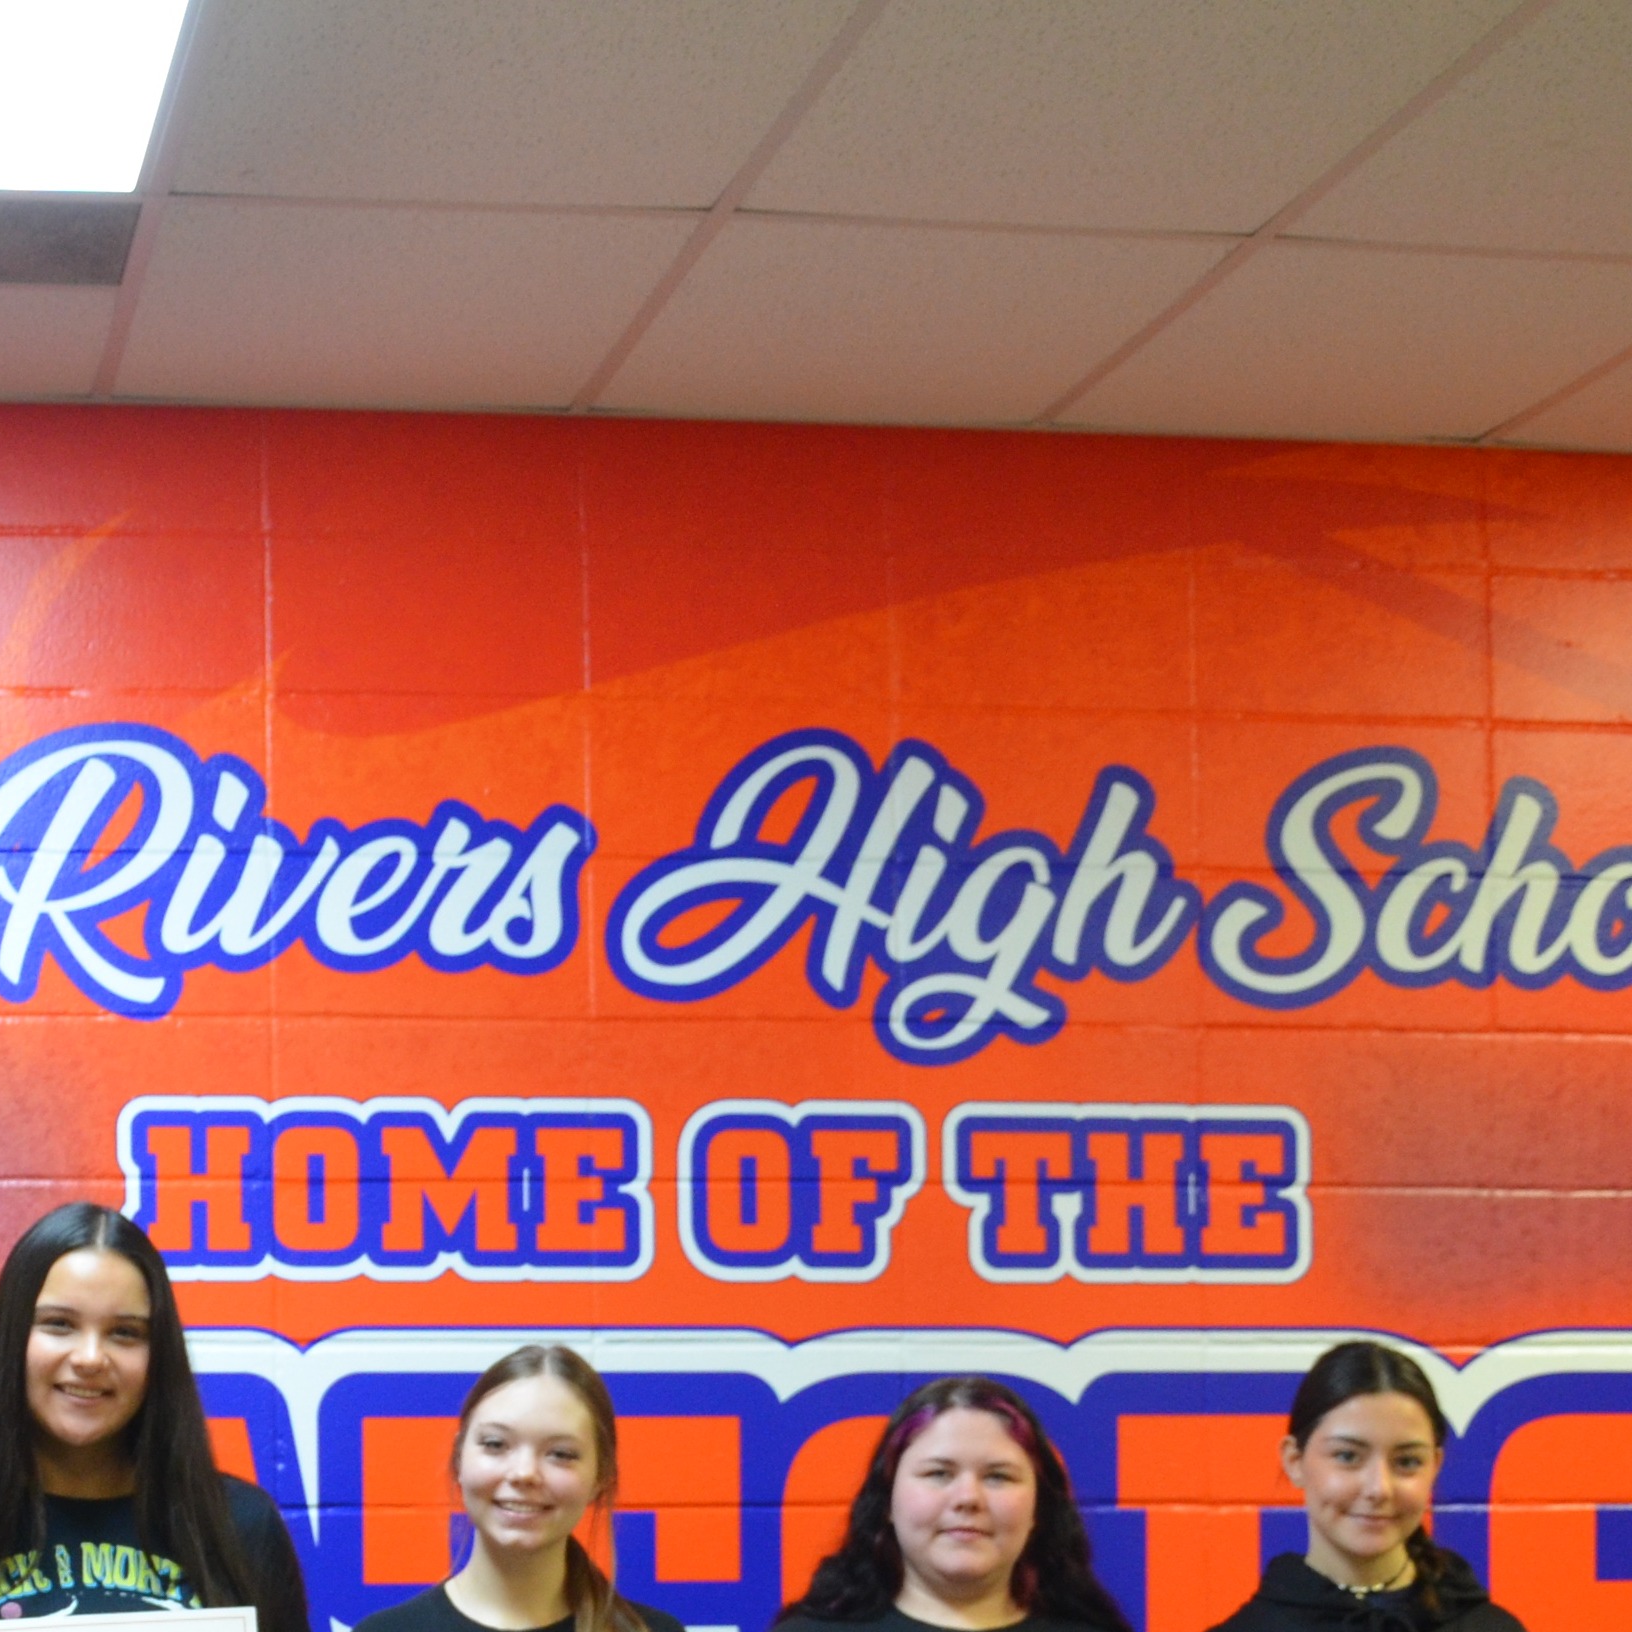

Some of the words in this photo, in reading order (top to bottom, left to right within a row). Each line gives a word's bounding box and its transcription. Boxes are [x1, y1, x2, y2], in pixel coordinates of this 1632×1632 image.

[614, 736, 1194, 1057] High
[138, 1117, 632, 1260] HOME
[699, 1120, 906, 1261] OF
[963, 1125, 1292, 1262] THE
